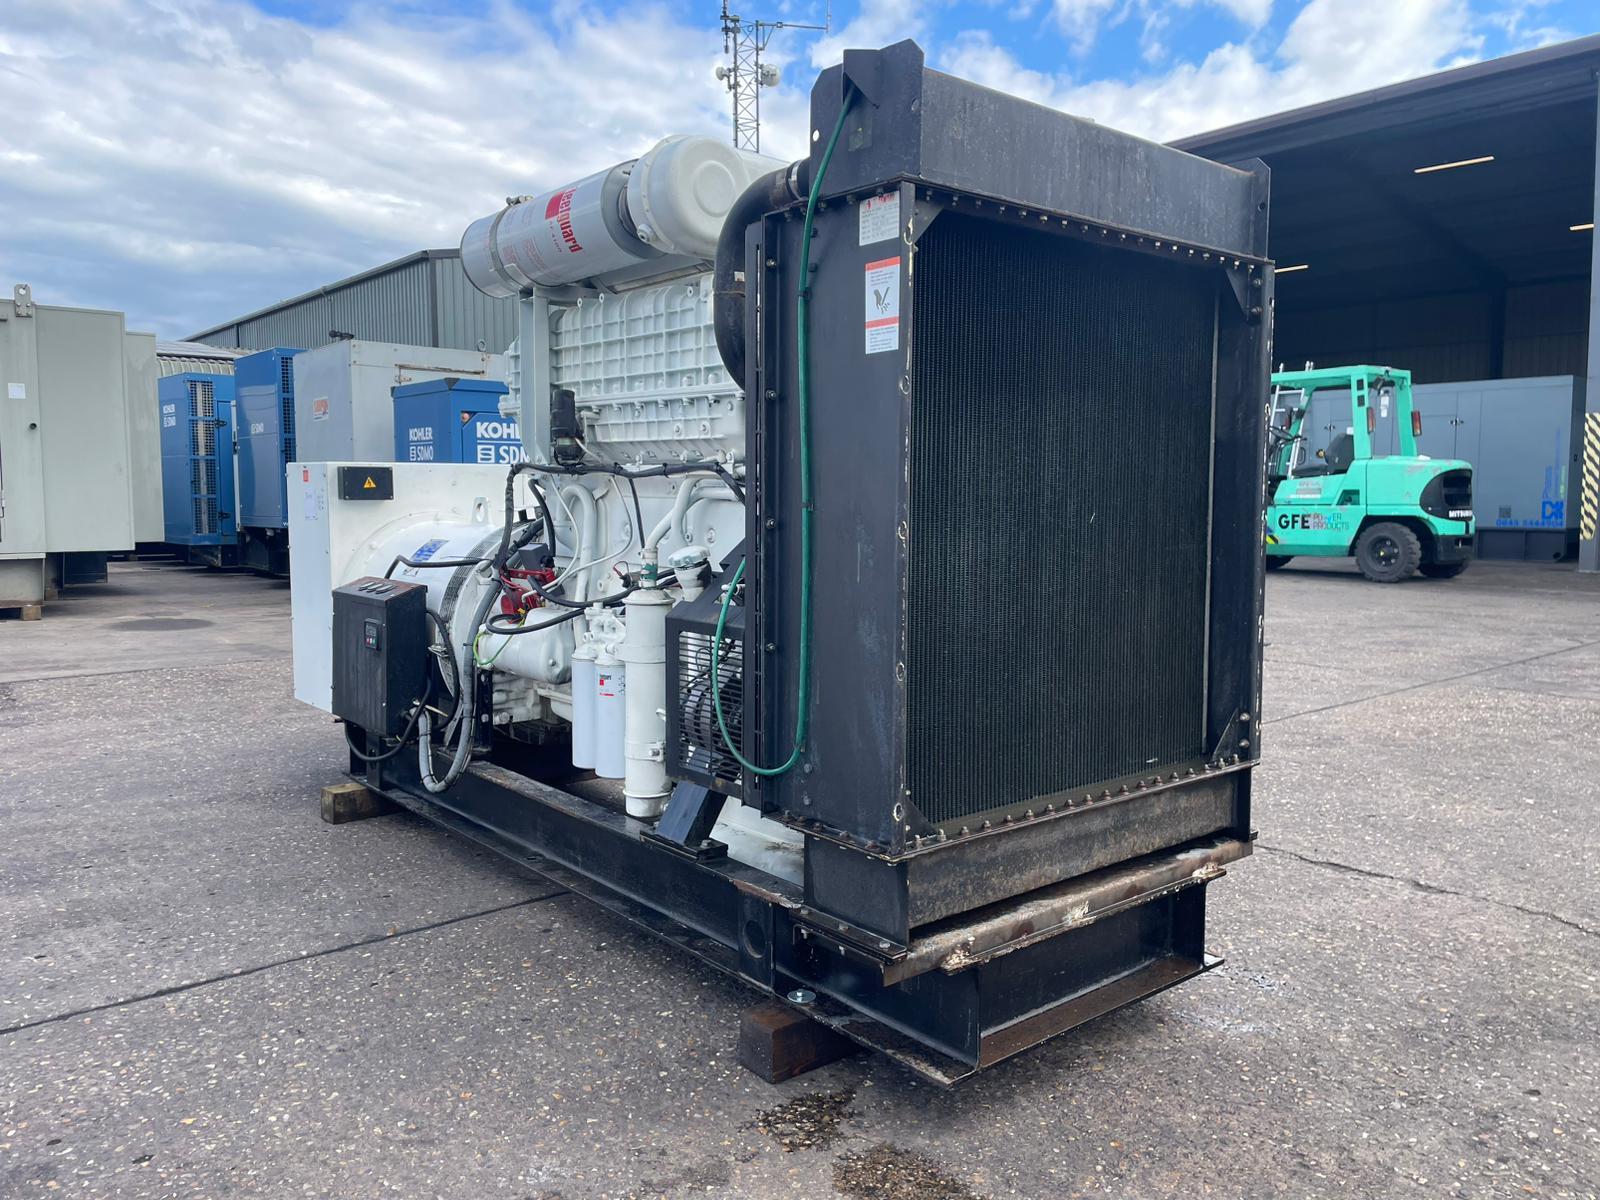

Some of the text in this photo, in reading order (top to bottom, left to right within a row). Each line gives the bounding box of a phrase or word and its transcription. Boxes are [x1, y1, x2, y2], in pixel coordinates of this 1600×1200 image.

[556, 187, 583, 253] leetguard
[409, 427, 433, 441] KOHLER
[476, 421, 521, 439] KOHL
[417, 446, 434, 461] SDMO
[1278, 513, 1310, 529] GFE
